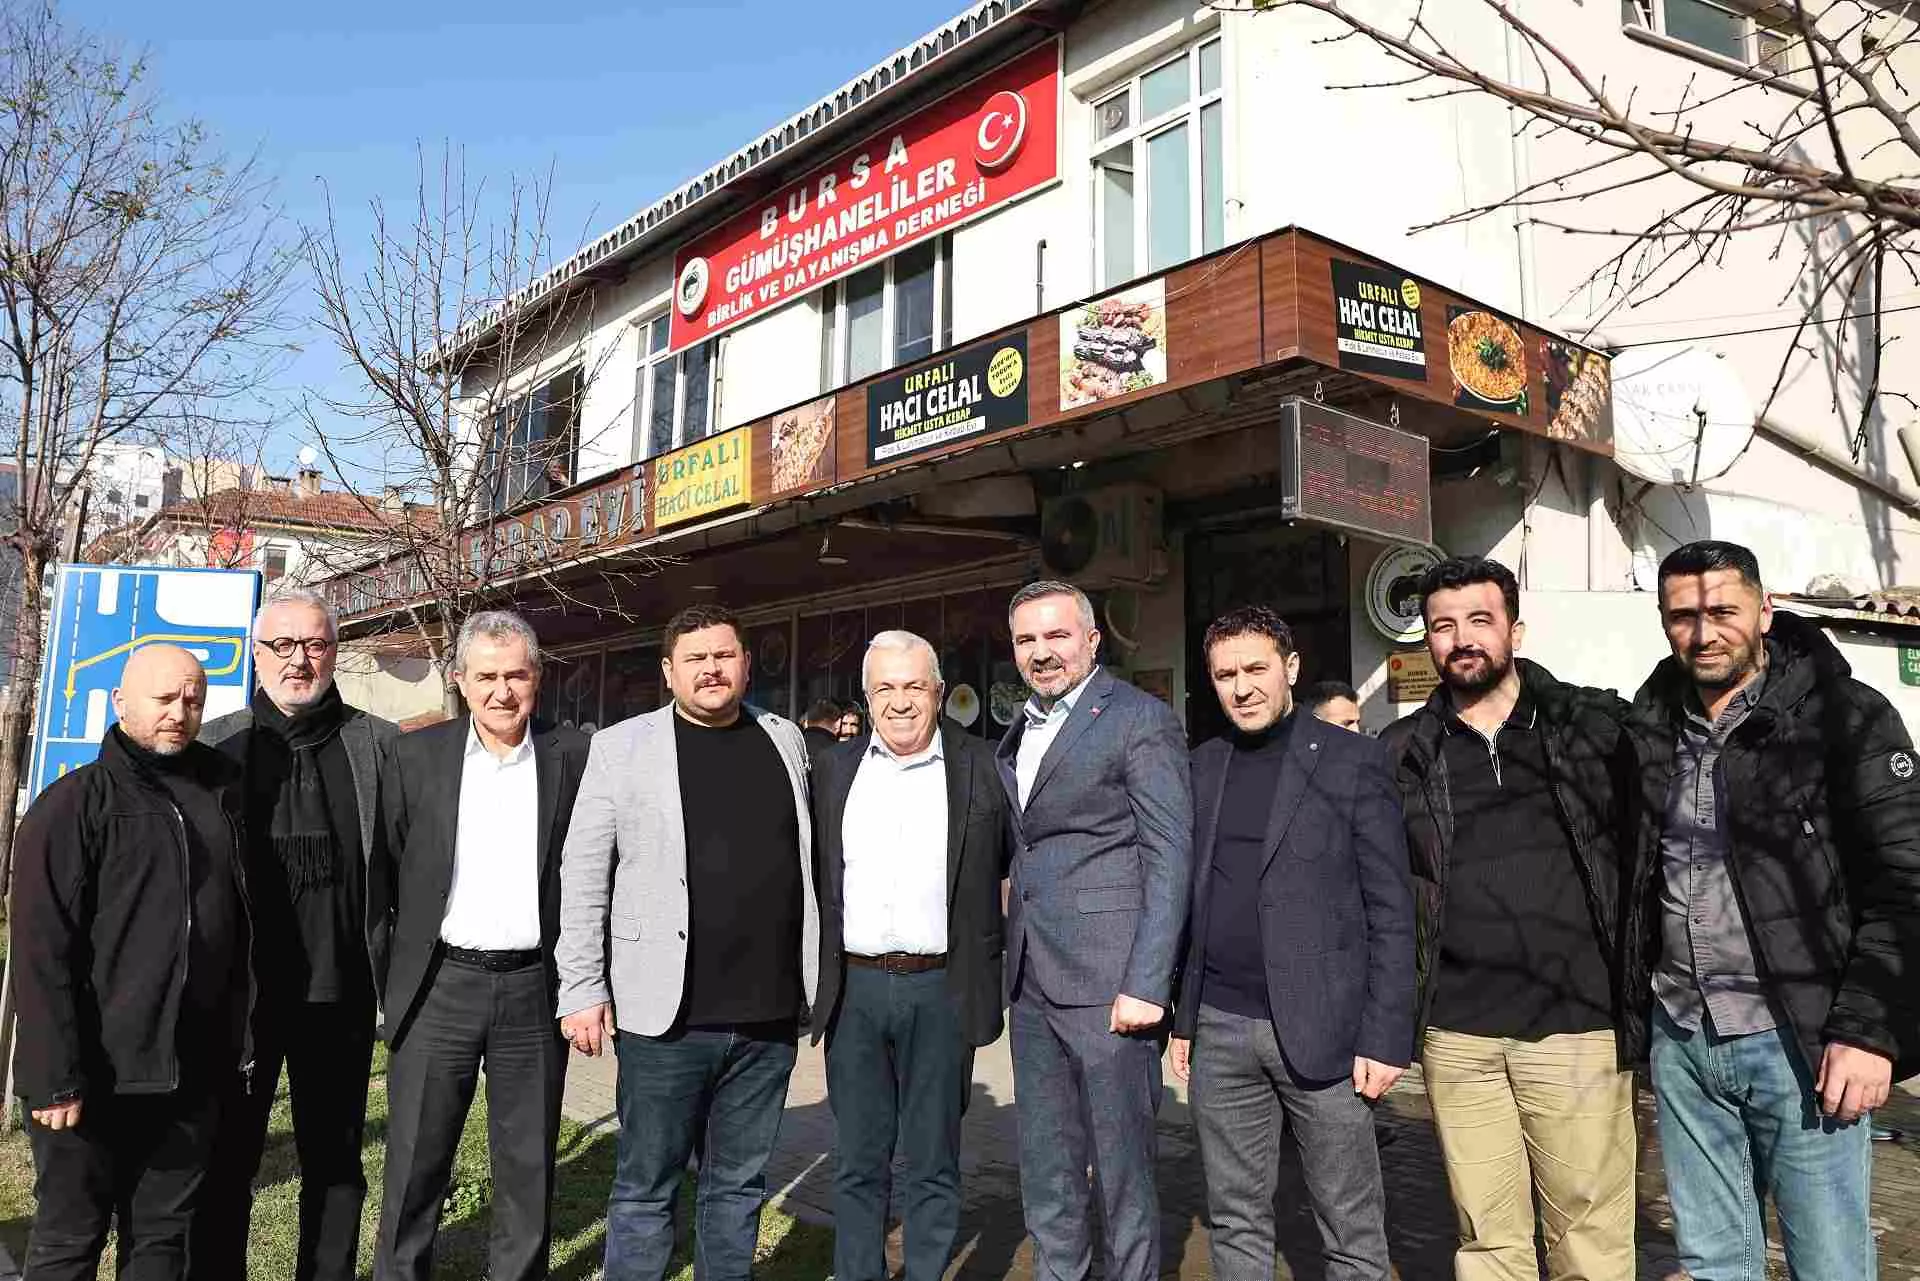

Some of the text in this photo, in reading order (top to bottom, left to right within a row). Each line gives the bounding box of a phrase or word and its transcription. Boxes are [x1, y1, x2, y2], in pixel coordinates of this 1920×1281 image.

[760, 135, 908, 240] BURSA
[726, 158, 956, 293] GÜMÜŞHANELİLER
[707, 291, 753, 328] BİRLİK
[760, 280, 779, 302] VE
[895, 176, 985, 240] DERNEĞİ
[1359, 281, 1398, 305] URFALI
[1339, 297, 1421, 338] HACI CELAL
[905, 362, 954, 394] URFALI
[880, 375, 982, 432] HACI CELAL
[924, 416, 945, 431] USTA
[695, 475, 739, 507] CELAL
